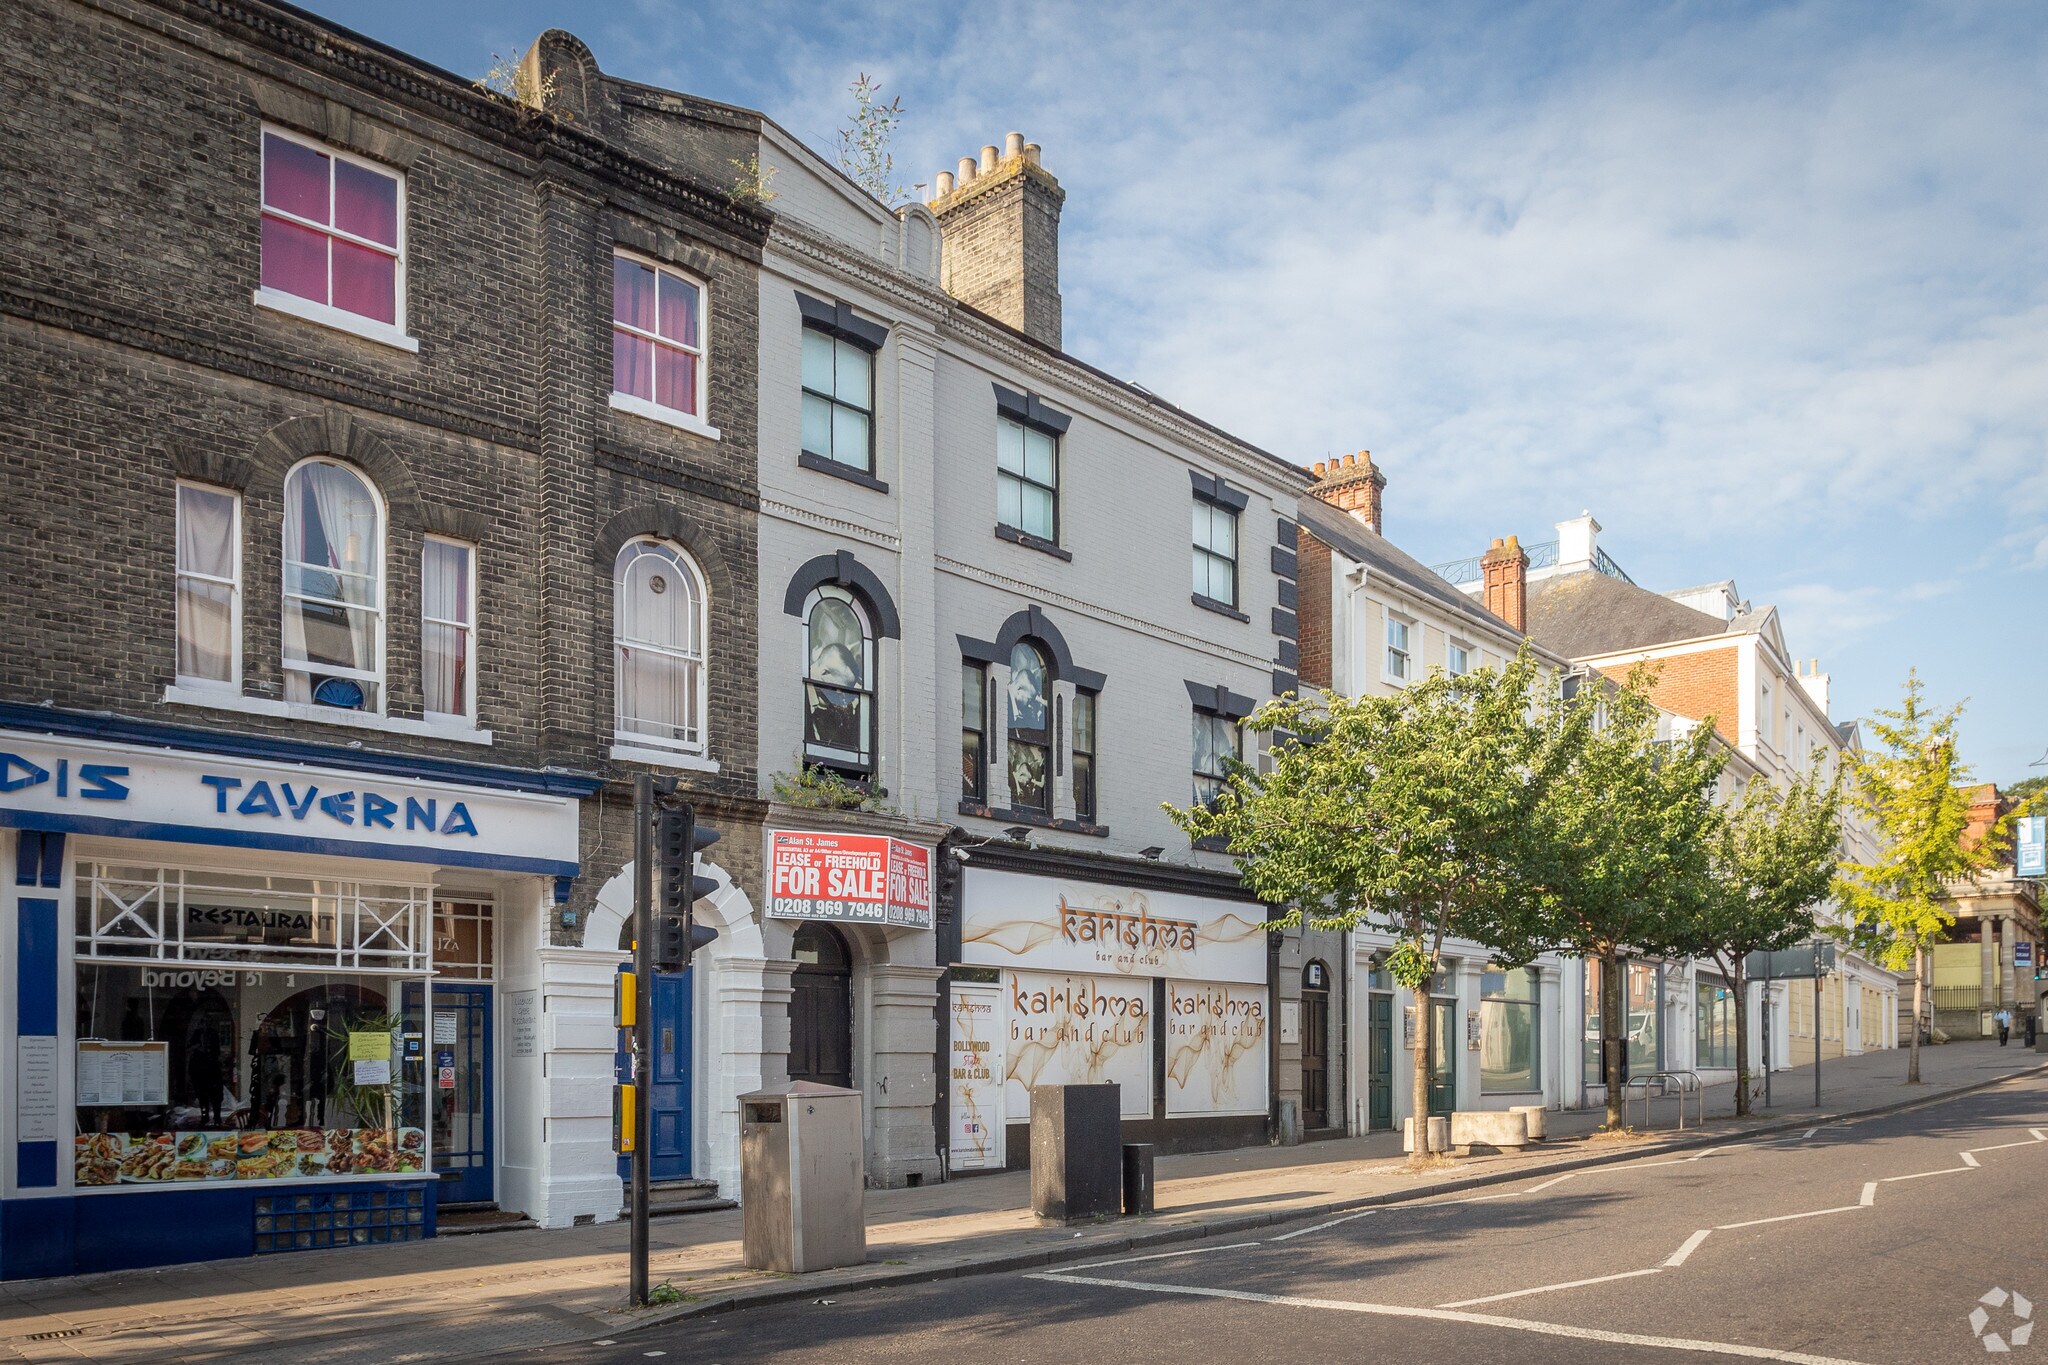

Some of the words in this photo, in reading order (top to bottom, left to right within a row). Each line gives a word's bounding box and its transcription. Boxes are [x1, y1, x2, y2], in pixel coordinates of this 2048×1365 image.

[201, 774, 479, 837] TAVERNA
[789, 837, 803, 845] Alan
[805, 837, 814, 846] St.
[816, 838, 839, 847] James
[776, 852, 811, 867] LEASE
[825, 855, 881, 870] FREEHOLD
[891, 860, 904, 875] LEASE
[907, 863, 927, 880] FREEHOLD
[775, 866, 820, 895] FOR
[828, 868, 885, 899] SALE
[890, 873, 907, 903] FOR
[909, 876, 929, 907] SALE
[774, 898, 811, 914] 0208
[816, 900, 843, 916] 969
[848, 902, 883, 918] 7946
[888, 904, 904, 920] 0208
[904, 907, 915, 922] 969
[916, 909, 929, 924] 7946
[188, 907, 334, 931] RESTAURANT
[1057, 893, 1199, 953] karishma
[438, 937, 459, 951] 17A
[1096, 951, 1112, 962] bar
[1117, 953, 1135, 964] and
[1139, 955, 1159, 966] club
[1010, 974, 1146, 1019] karishma
[1170, 984, 1263, 1019] karishma
[1010, 1019, 1048, 1042] bar
[1056, 1020, 1094, 1043] and
[1101, 1022, 1144, 1044] club
[1169, 1018, 1196, 1036] bar
[1200, 1020, 1228, 1037] and
[1231, 1019, 1263, 1037] club
[953, 1041, 990, 1052] BOLLYWOOD
[953, 1068, 967, 1080] BAR
[967, 1068, 973, 1080] &
[973, 1068, 990, 1080] CLUB
